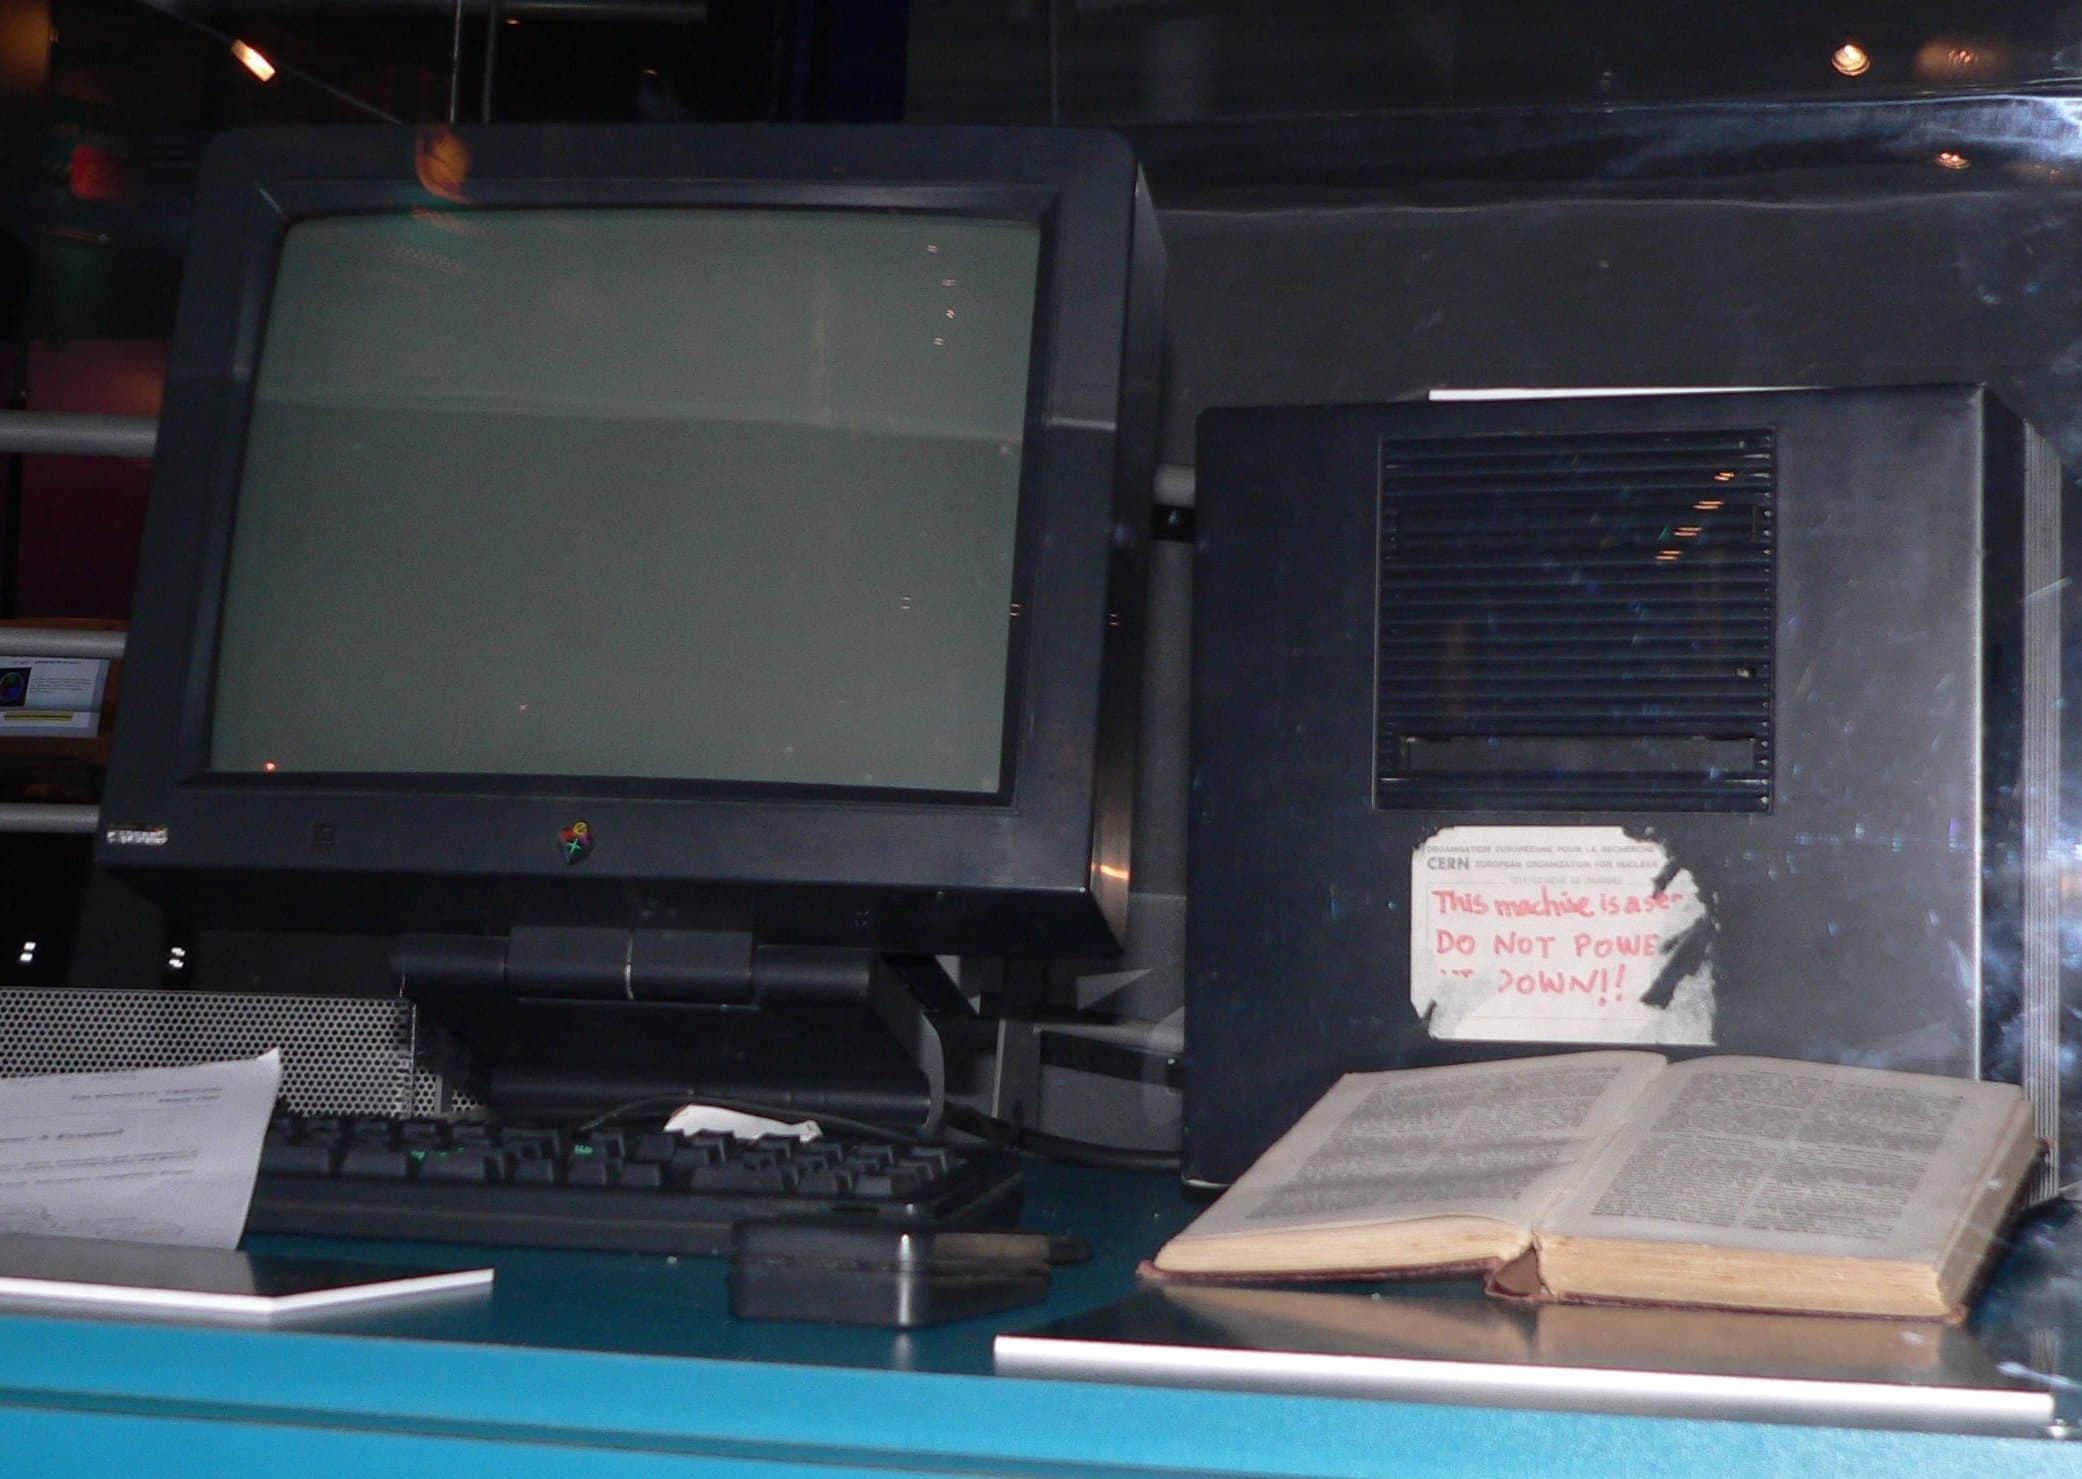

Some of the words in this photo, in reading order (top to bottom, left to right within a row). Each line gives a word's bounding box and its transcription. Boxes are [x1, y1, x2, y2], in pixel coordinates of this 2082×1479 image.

[1426, 856, 1470, 870] CERN
[1431, 889, 1489, 915] This
[1493, 885, 1596, 917] machine
[1599, 893, 1620, 915] is
[1622, 896, 1642, 914] a
[1434, 929, 1476, 955] DO
[1493, 931, 1556, 959] NOT
[1573, 933, 1660, 958] POWE
